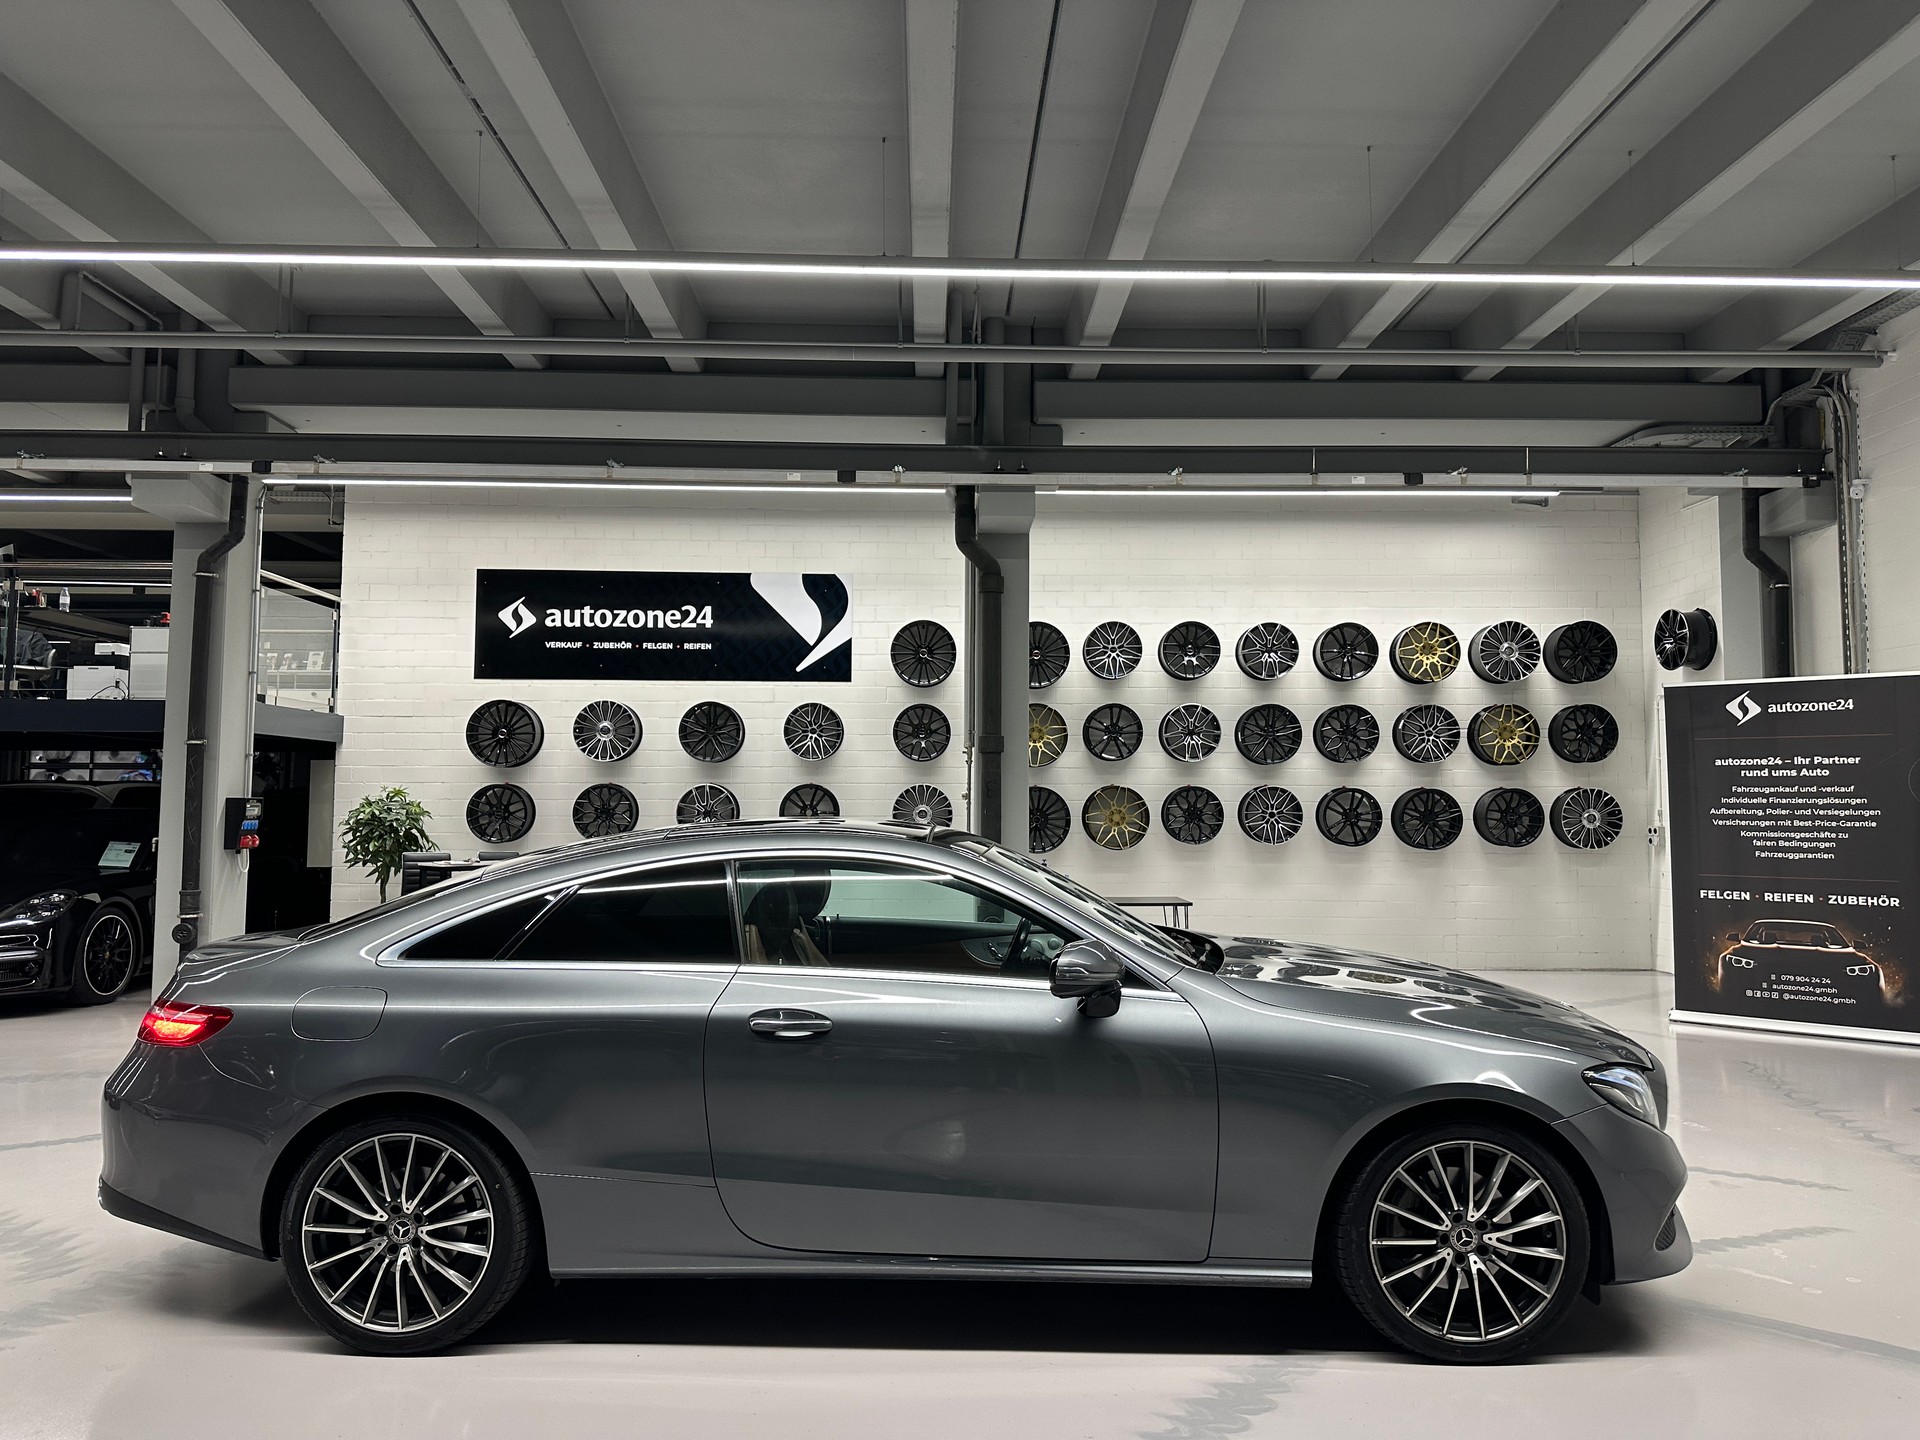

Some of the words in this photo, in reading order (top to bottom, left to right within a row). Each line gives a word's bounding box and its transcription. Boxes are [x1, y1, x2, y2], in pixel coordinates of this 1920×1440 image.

[544, 605, 713, 629] autozone24
[544, 641, 583, 649] VERKAUF
[592, 640, 632, 650] ZUBEHÖR
[642, 642, 674, 650] FELGEN
[683, 642, 712, 650] REIFEN
[1767, 699, 1854, 713] autozone24
[1714, 757, 1782, 766] autozone24
[1794, 756, 1811, 765] Ihr
[1813, 756, 1861, 765] Partner
[1740, 768, 1769, 777] rund
[1771, 769, 1797, 777] ums
[1799, 768, 1830, 777] Auto
[1731, 785, 1798, 793] Fahrzeugankauf
[1800, 785, 1817, 793] und
[1818, 785, 1855, 793] -verkauf
[1768, 796, 1867, 805] Finanzierungslösungen
[1709, 807, 1765, 816] Aufbereitung,
[1812, 808, 1881, 817] Versiegelungen
[1712, 818, 1776, 827] Versicherungen
[1777, 819, 1792, 827] mit
[1793, 820, 1877, 828] Best-Price-Garantie
[1740, 830, 1836, 839] Kommissionsgeschäfte
[1752, 839, 1777, 847] fairen
[1778, 840, 1836, 849] Bedingungen
[1755, 850, 1835, 860] Fahrzeuggarantien
[1699, 889, 1750, 901] FELGEN
[1764, 892, 1814, 904] REIFEN
[1828, 894, 1900, 907] ZUBEHÖR
[1772, 983, 1838, 994] autozone24.gmbh
[1782, 993, 1857, 1005] @autozone24.gmbh
